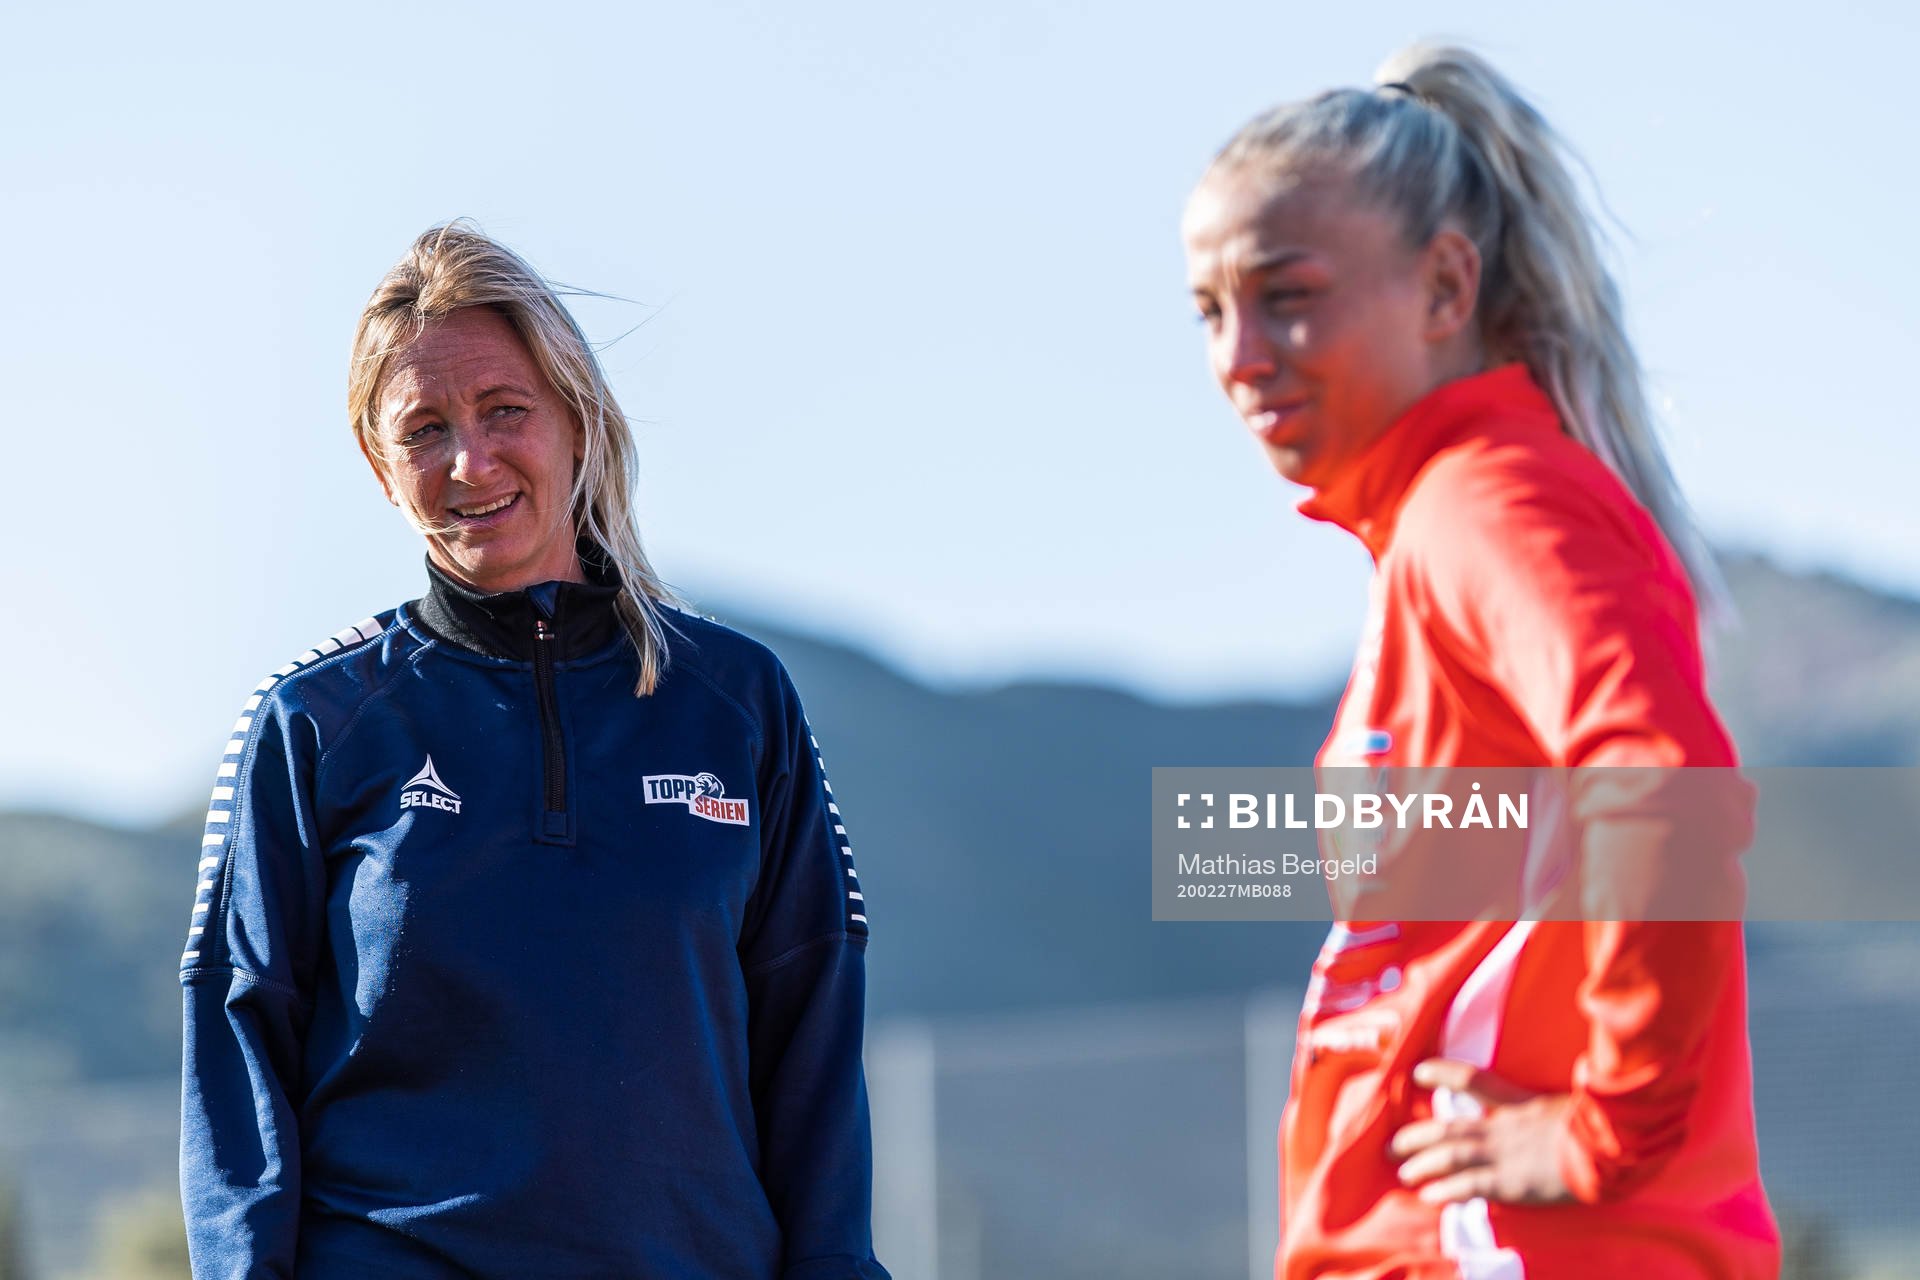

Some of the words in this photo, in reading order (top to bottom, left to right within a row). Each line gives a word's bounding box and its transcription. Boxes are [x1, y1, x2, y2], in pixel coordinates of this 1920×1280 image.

[648, 779, 696, 801] TOPP
[400, 791, 462, 814] SELECT
[695, 795, 746, 821] SERIEN
